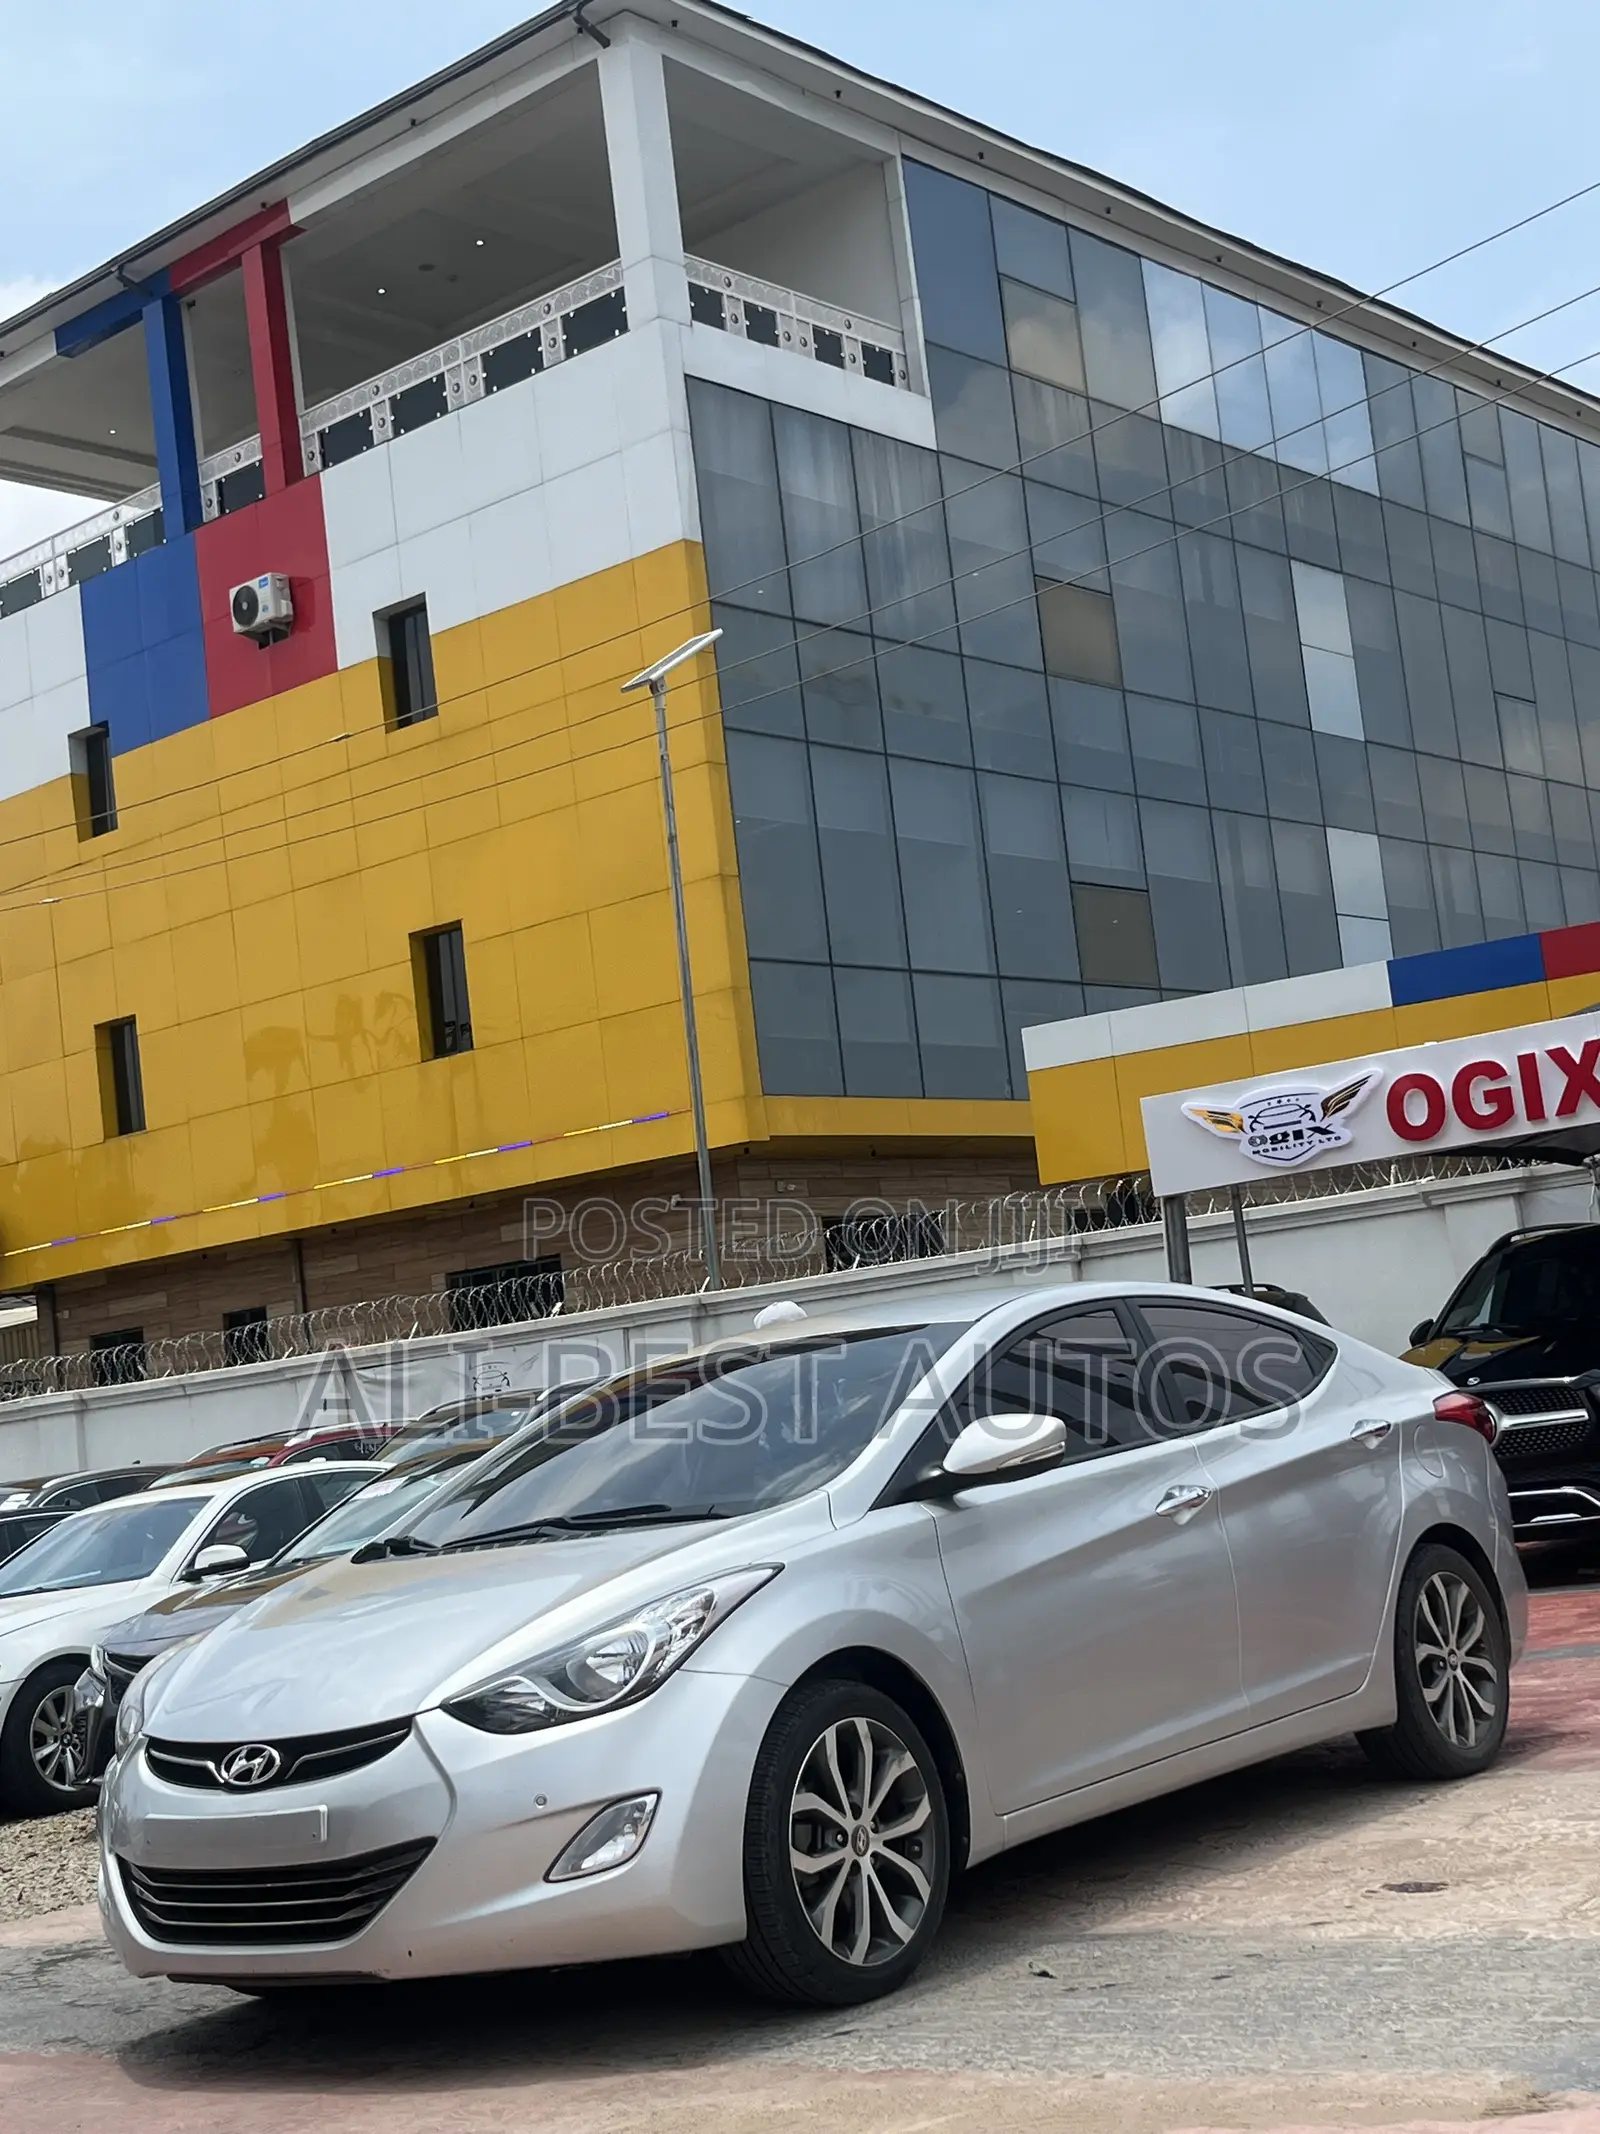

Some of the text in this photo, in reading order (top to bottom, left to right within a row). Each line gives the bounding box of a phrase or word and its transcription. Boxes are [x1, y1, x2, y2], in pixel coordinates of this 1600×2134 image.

[1386, 1038, 1600, 1142] OGIX
[1252, 1135, 1342, 1155] MOBILITY LTD
